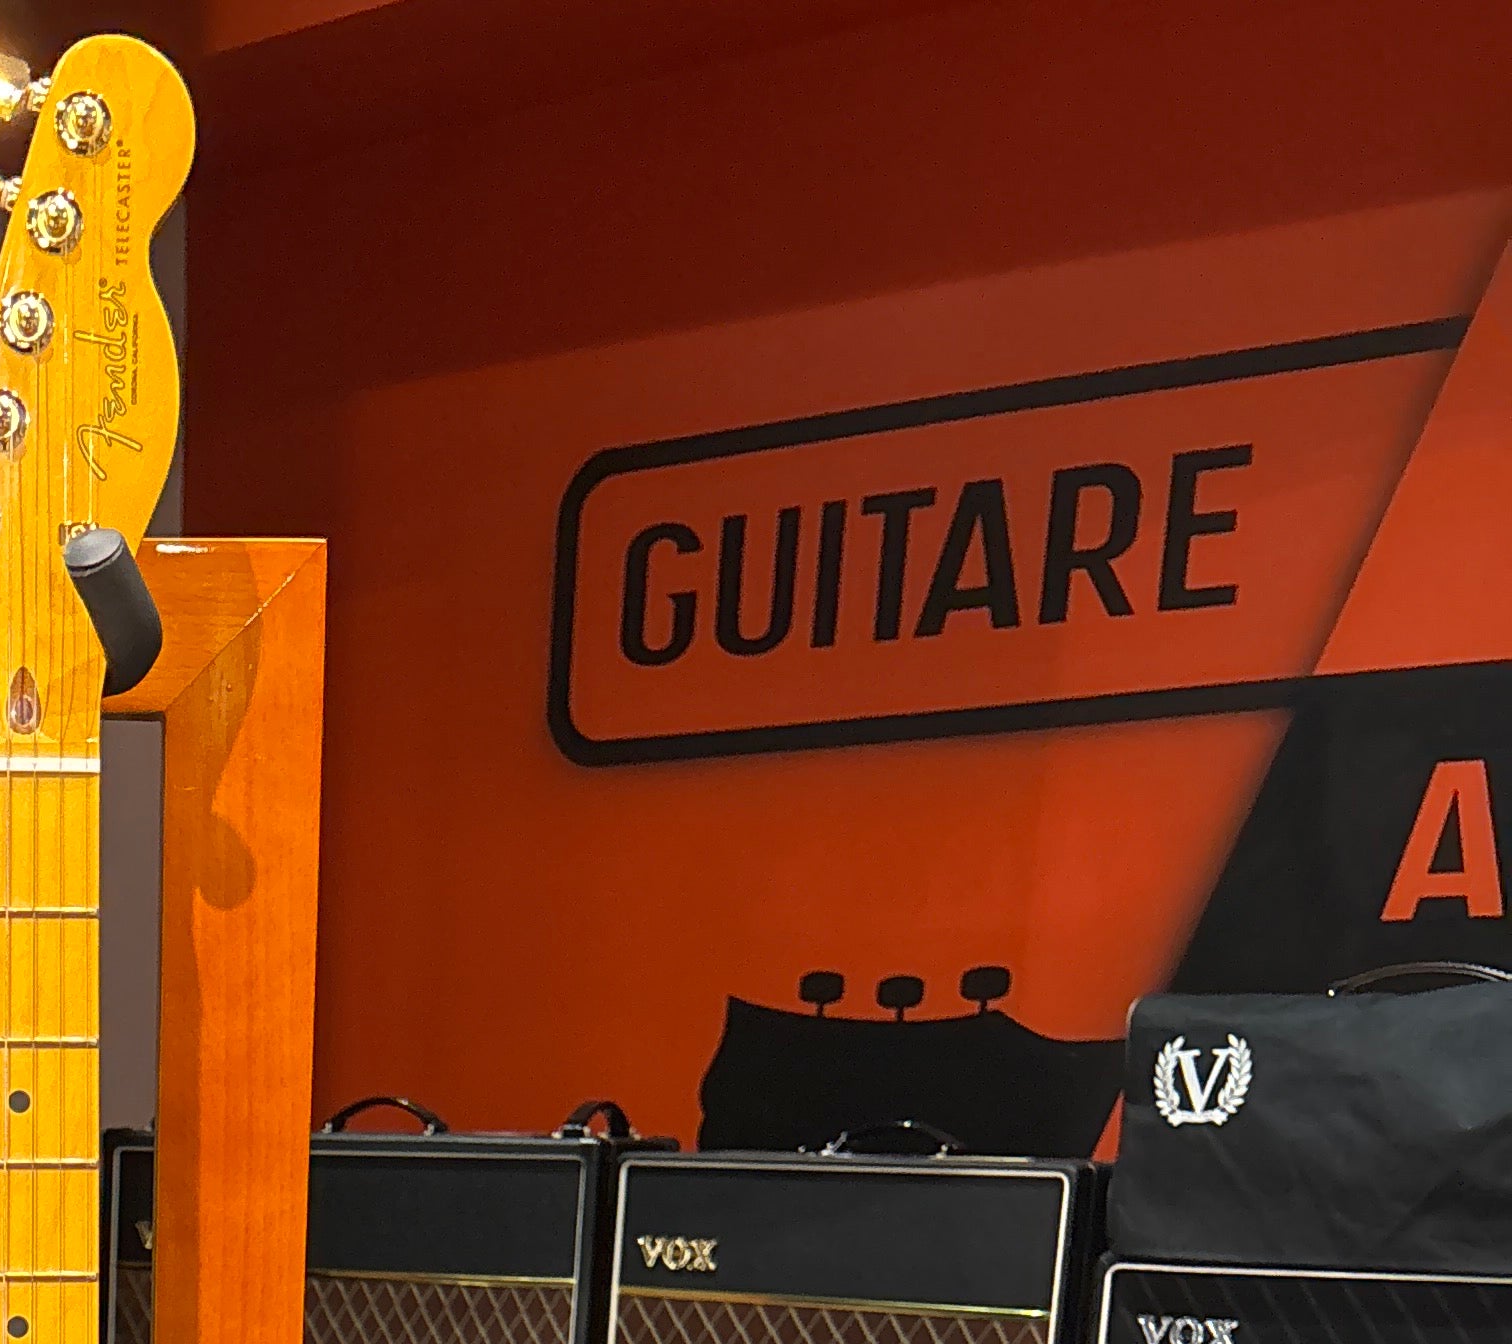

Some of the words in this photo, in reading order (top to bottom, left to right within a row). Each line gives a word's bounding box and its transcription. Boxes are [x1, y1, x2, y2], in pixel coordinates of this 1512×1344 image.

[620, 443, 1253, 668] GUITARE
[1379, 760, 1504, 922] A
[637, 1235, 717, 1271] VOX
